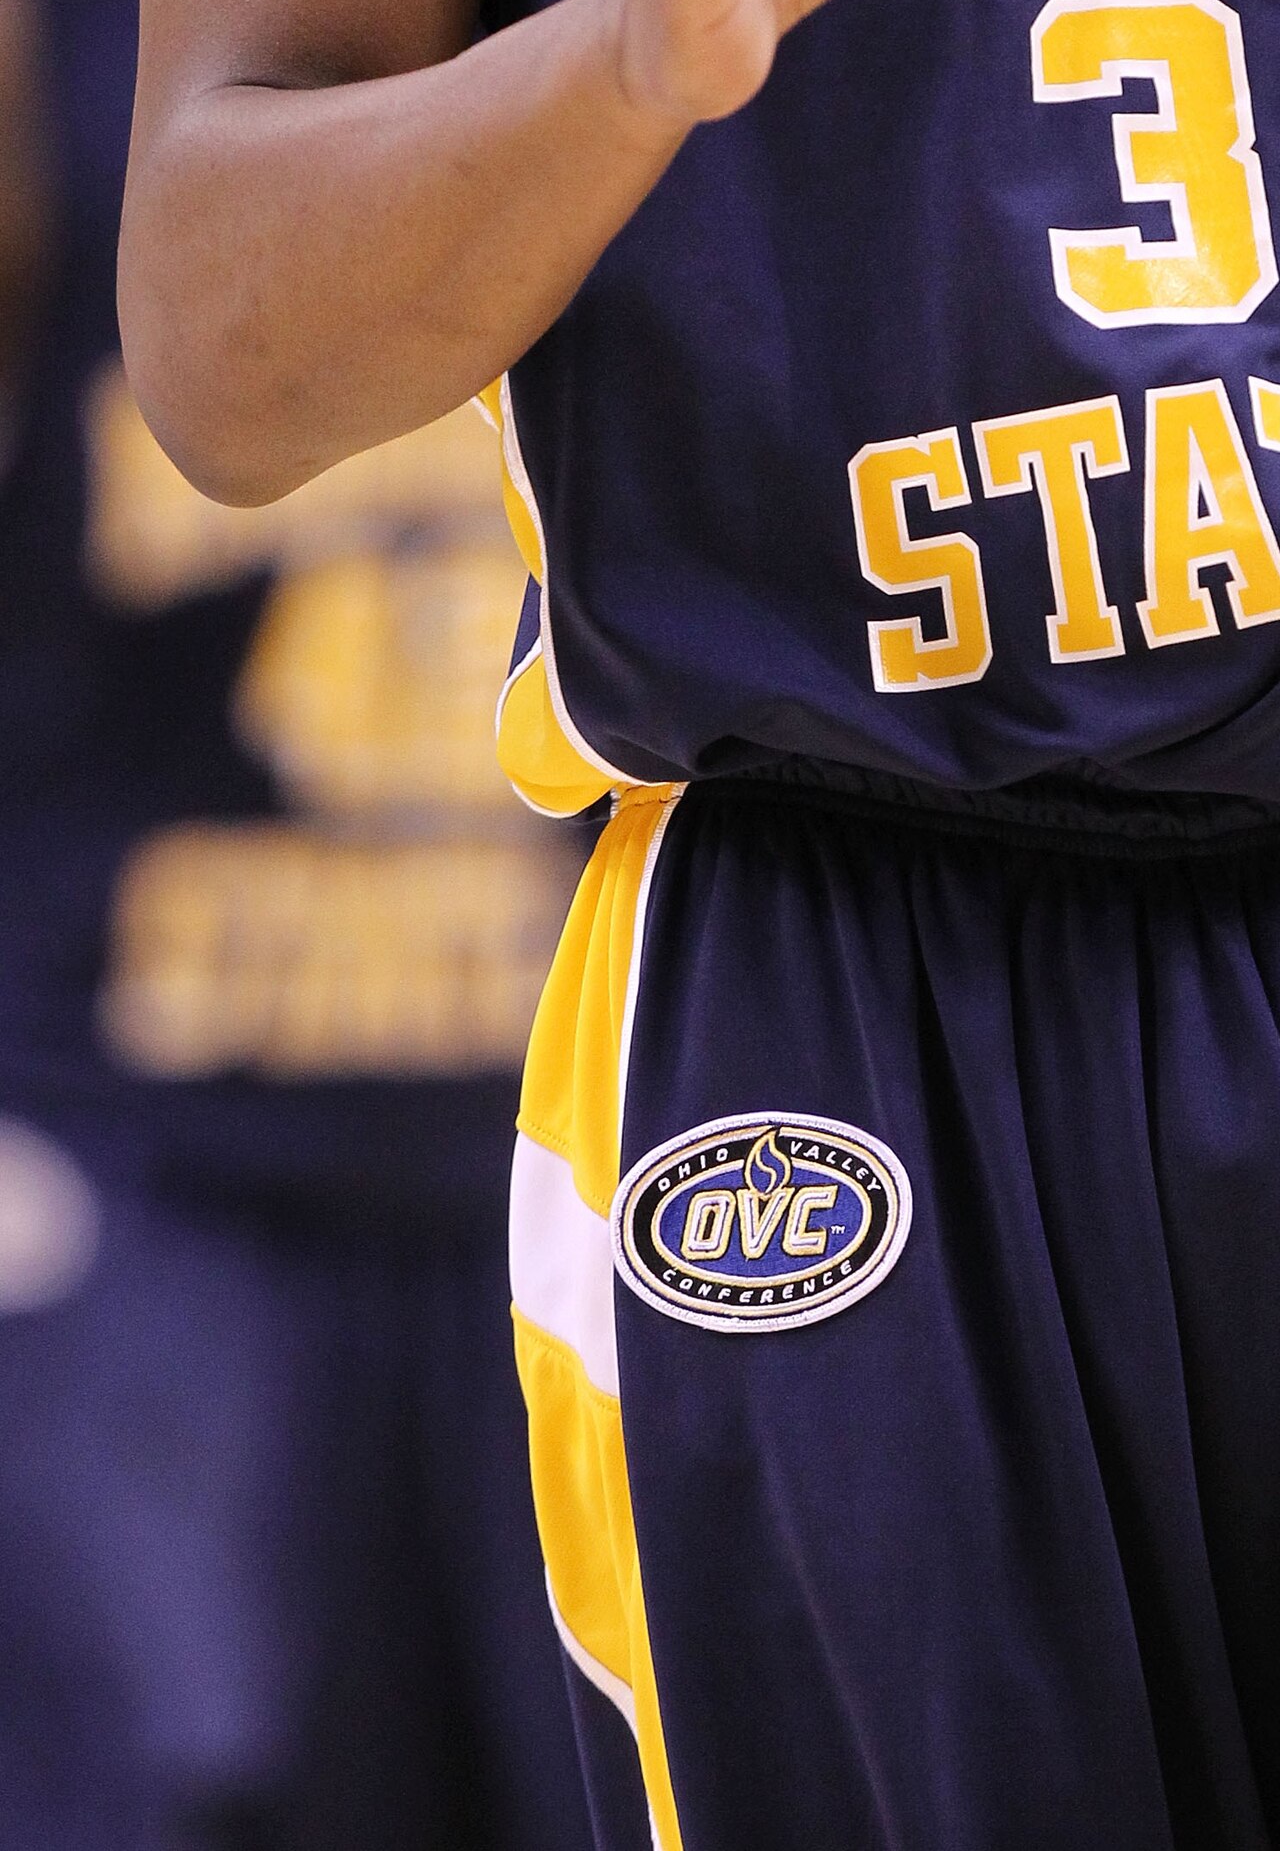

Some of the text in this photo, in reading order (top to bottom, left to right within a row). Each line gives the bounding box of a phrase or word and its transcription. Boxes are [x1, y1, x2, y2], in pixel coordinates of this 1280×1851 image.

[658, 1140, 882, 1192] OHIO VALLEY
[681, 1184, 839, 1261] OVC
[662, 1260, 853, 1304] CONFERENCE
